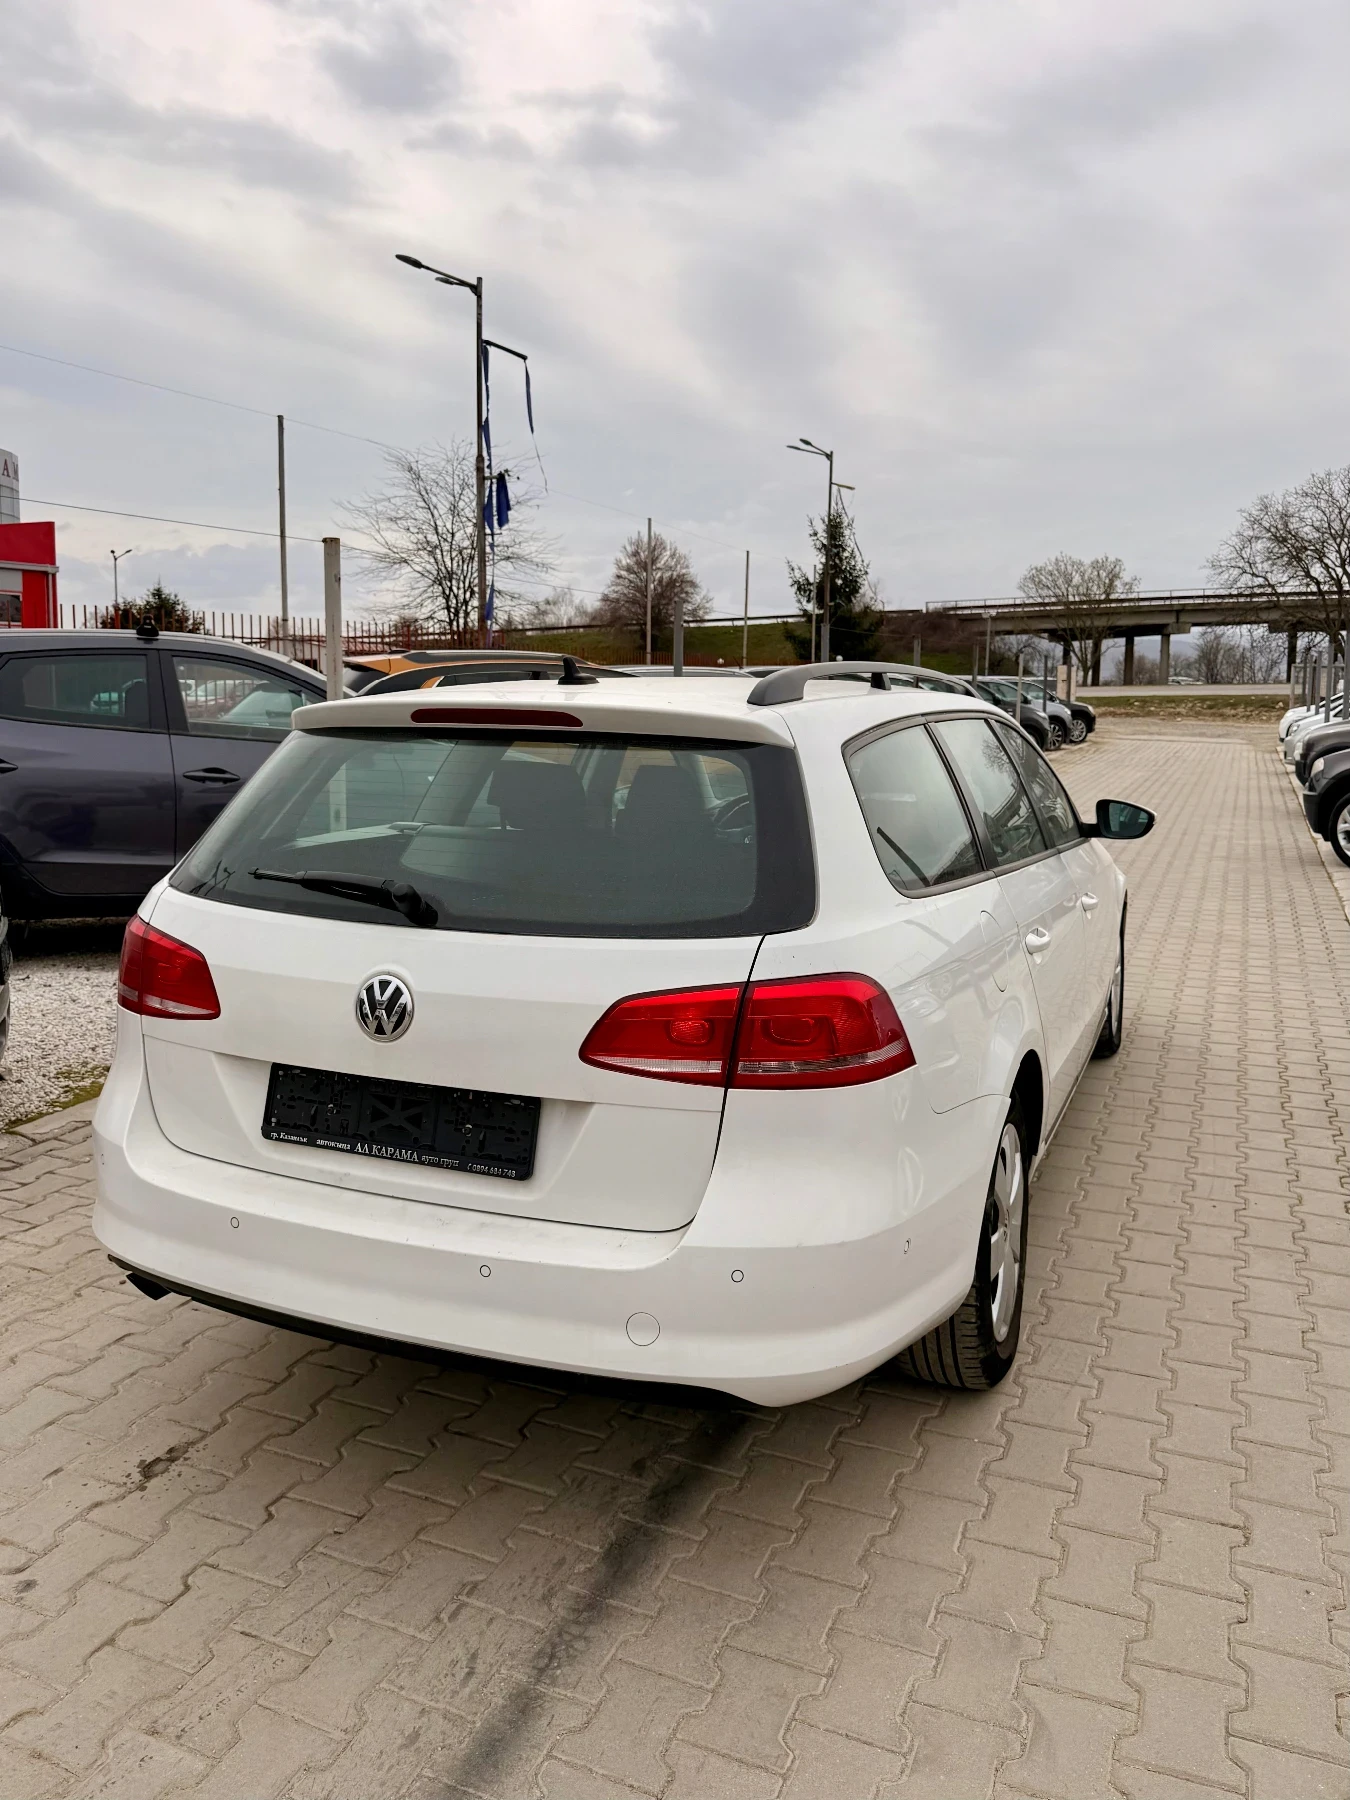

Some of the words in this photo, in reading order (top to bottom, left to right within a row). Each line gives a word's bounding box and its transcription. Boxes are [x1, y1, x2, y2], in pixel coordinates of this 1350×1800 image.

[356, 974, 414, 1042] VW
[354, 1142, 369, 1154] АЛ
[371, 1144, 419, 1162] КАРАМА
